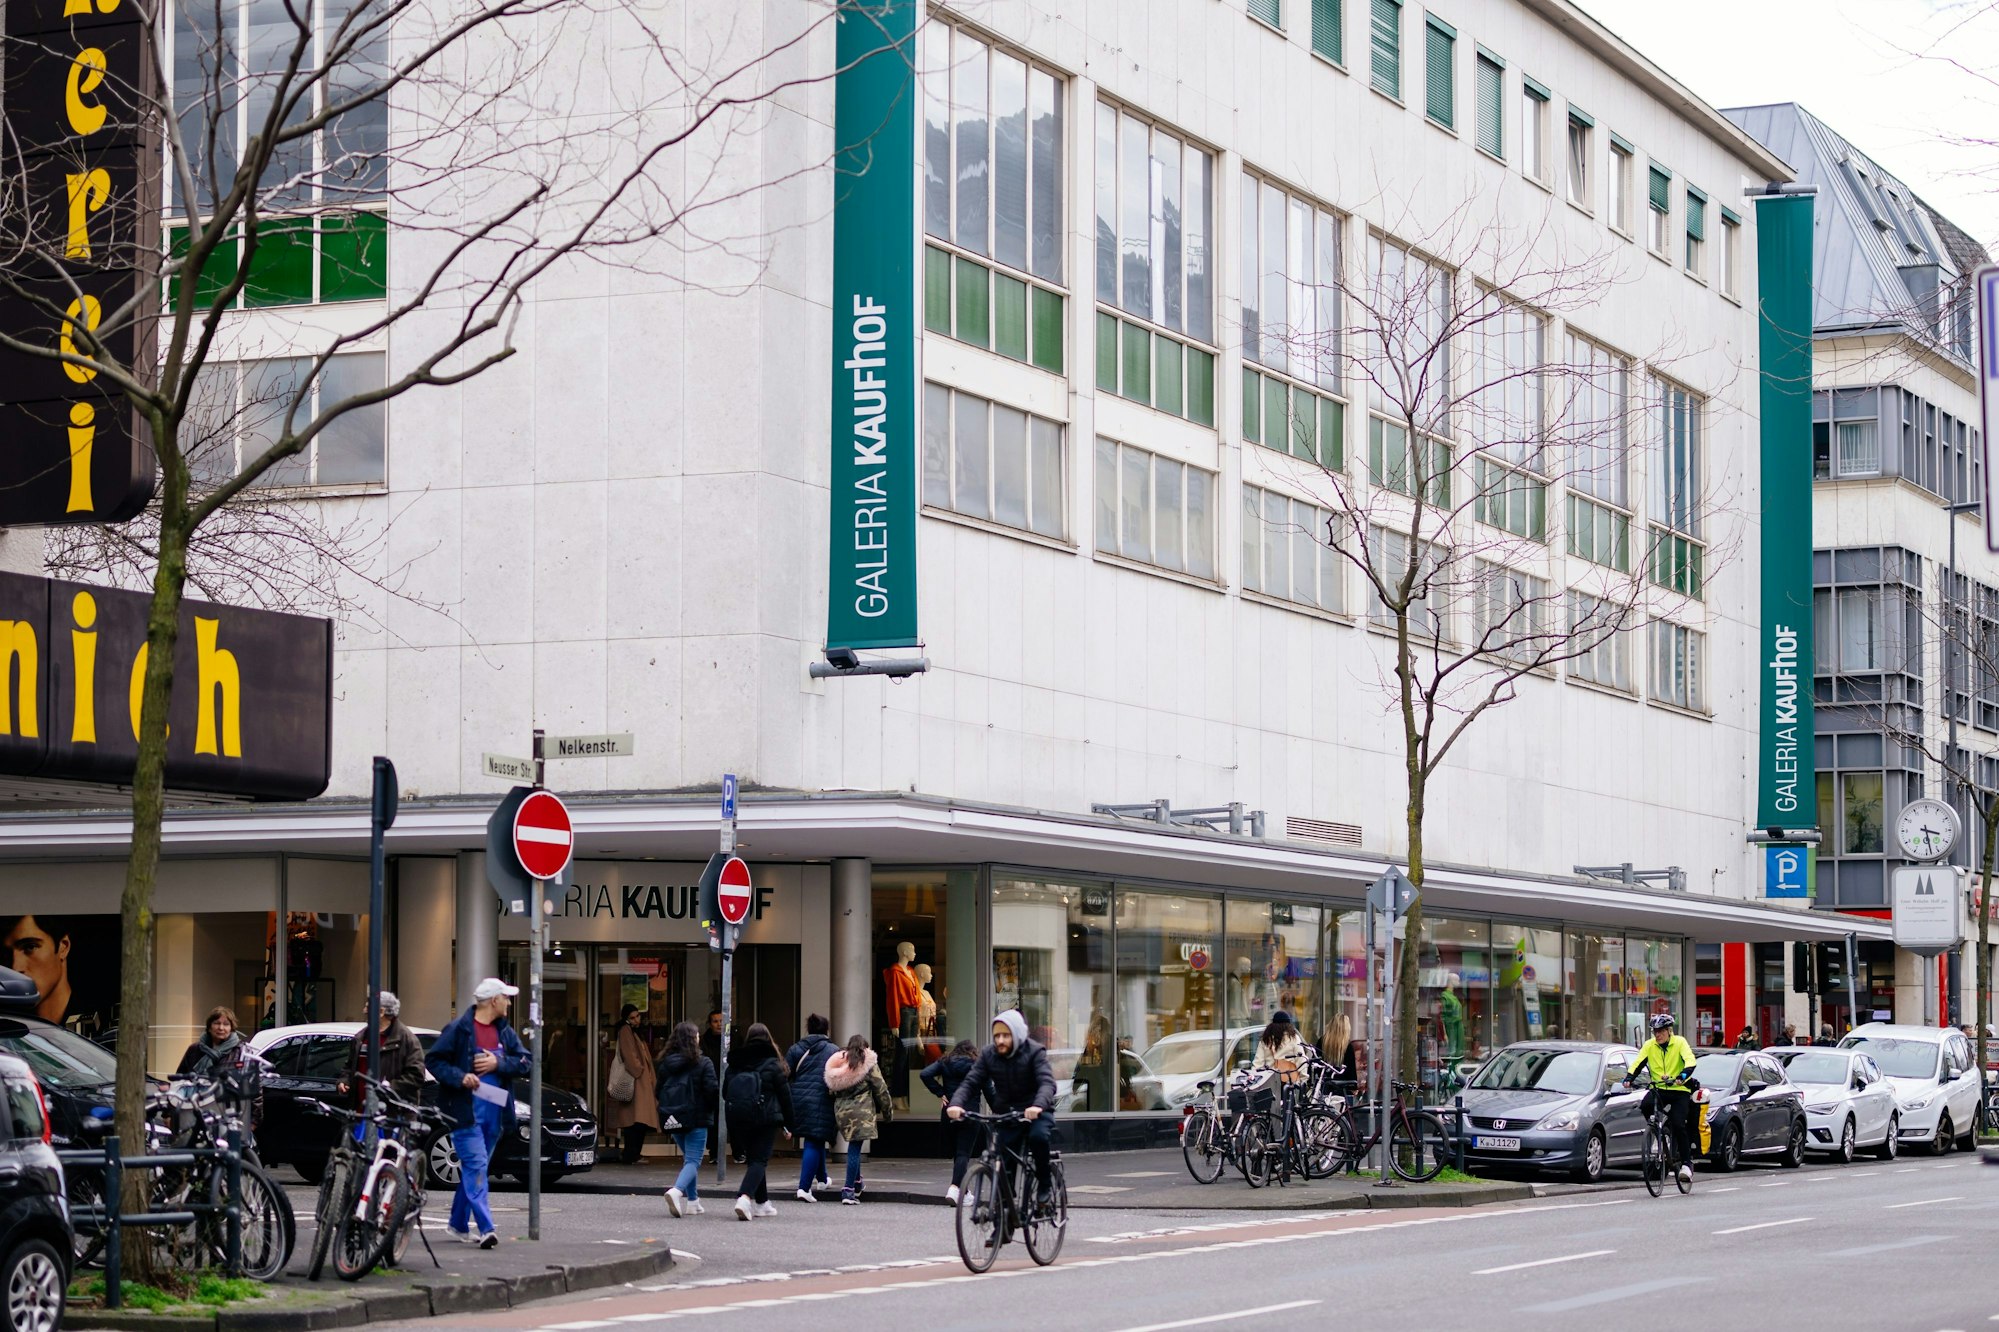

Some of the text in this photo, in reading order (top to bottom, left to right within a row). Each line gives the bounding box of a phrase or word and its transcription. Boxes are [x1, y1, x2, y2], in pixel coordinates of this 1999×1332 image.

[60, 0, 121, 513] erei
[854, 470, 888, 618] GALERIA
[559, 738, 619, 755] Nelkenstr.
[488, 757, 533, 778] Neusser Str.
[1775, 726, 1798, 812] GALERIA
[724, 779, 733, 813] P
[1778, 857, 1798, 883] P
[622, 884, 775, 920] KAUFF
[1480, 1137, 1485, 1146] K
